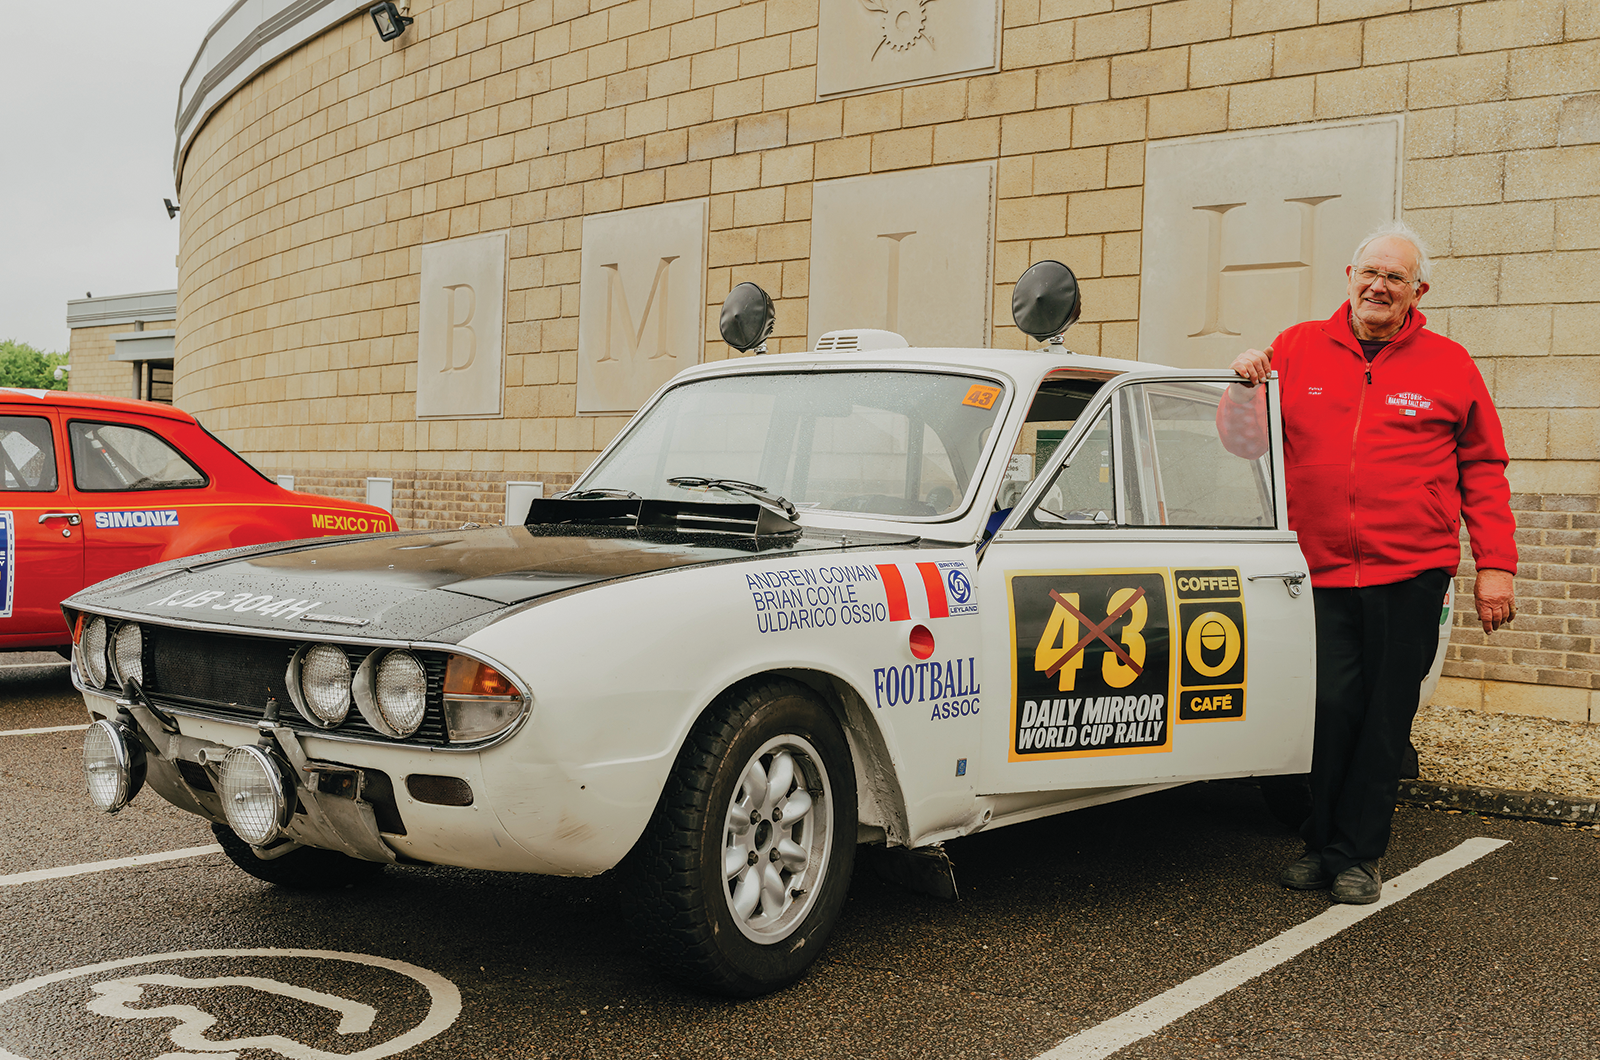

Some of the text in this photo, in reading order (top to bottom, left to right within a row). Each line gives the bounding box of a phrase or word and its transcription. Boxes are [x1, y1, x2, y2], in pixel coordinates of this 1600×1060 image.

[439, 283, 477, 374] B
[598, 255, 680, 363] M
[1187, 194, 1342, 338] H
[967, 390, 993, 406] 43
[95, 511, 179, 528] SIMONIZ
[312, 513, 387, 533] MEXICO 70
[745, 564, 878, 591] ANDREW COWAN
[1177, 576, 1239, 591] COFFEE
[212, 592, 323, 620] 304H
[753, 584, 858, 611] BRIAN COYLE
[950, 605, 978, 614] LEYLAND
[756, 602, 887, 634] ULDARICO OSSIO
[1034, 587, 1149, 692] 43
[873, 657, 981, 709] FOOTBALL
[930, 698, 981, 722] ASSOC
[1020, 694, 1165, 728] DAILY MIRROR
[1190, 693, 1233, 713] CAFÉ
[1018, 721, 1164, 750] WORLD CUP RALLY
